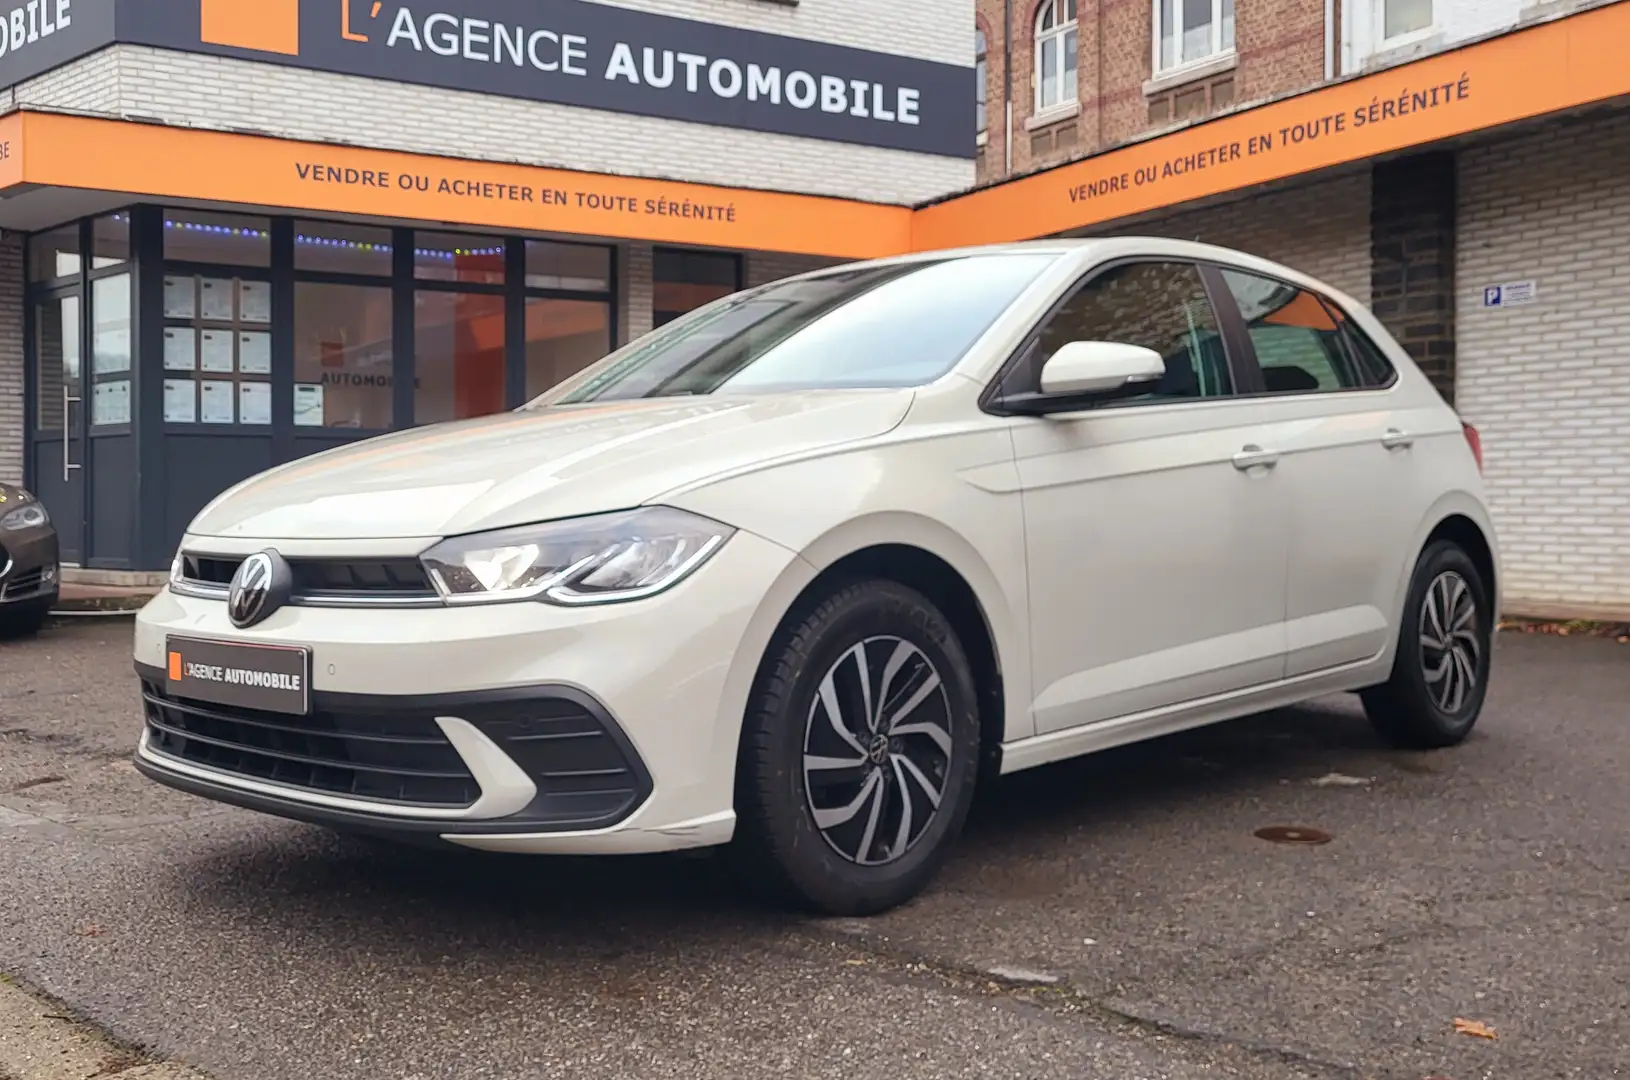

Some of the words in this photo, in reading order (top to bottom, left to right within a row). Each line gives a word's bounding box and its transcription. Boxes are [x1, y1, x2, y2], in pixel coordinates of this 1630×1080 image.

[341, 0, 588, 76] L'AGENCE
[604, 42, 920, 125] AUTOMOBILE
[1069, 173, 1129, 203] VENDRE
[1134, 165, 1157, 187] OU
[1162, 142, 1241, 179] ACHETER
[1248, 133, 1272, 155] EN
[1279, 112, 1346, 146] TOUTE
[1353, 71, 1471, 128] SÉRÉNITÉ
[295, 162, 390, 188] VENDRE
[398, 173, 429, 192] OU
[437, 178, 534, 203] ACHETER
[542, 188, 567, 205] EN
[575, 191, 638, 213] TOUTE
[645, 193, 737, 223] SÉRÉNITÉ
[224, 667, 300, 691] AUTOMOBILE
